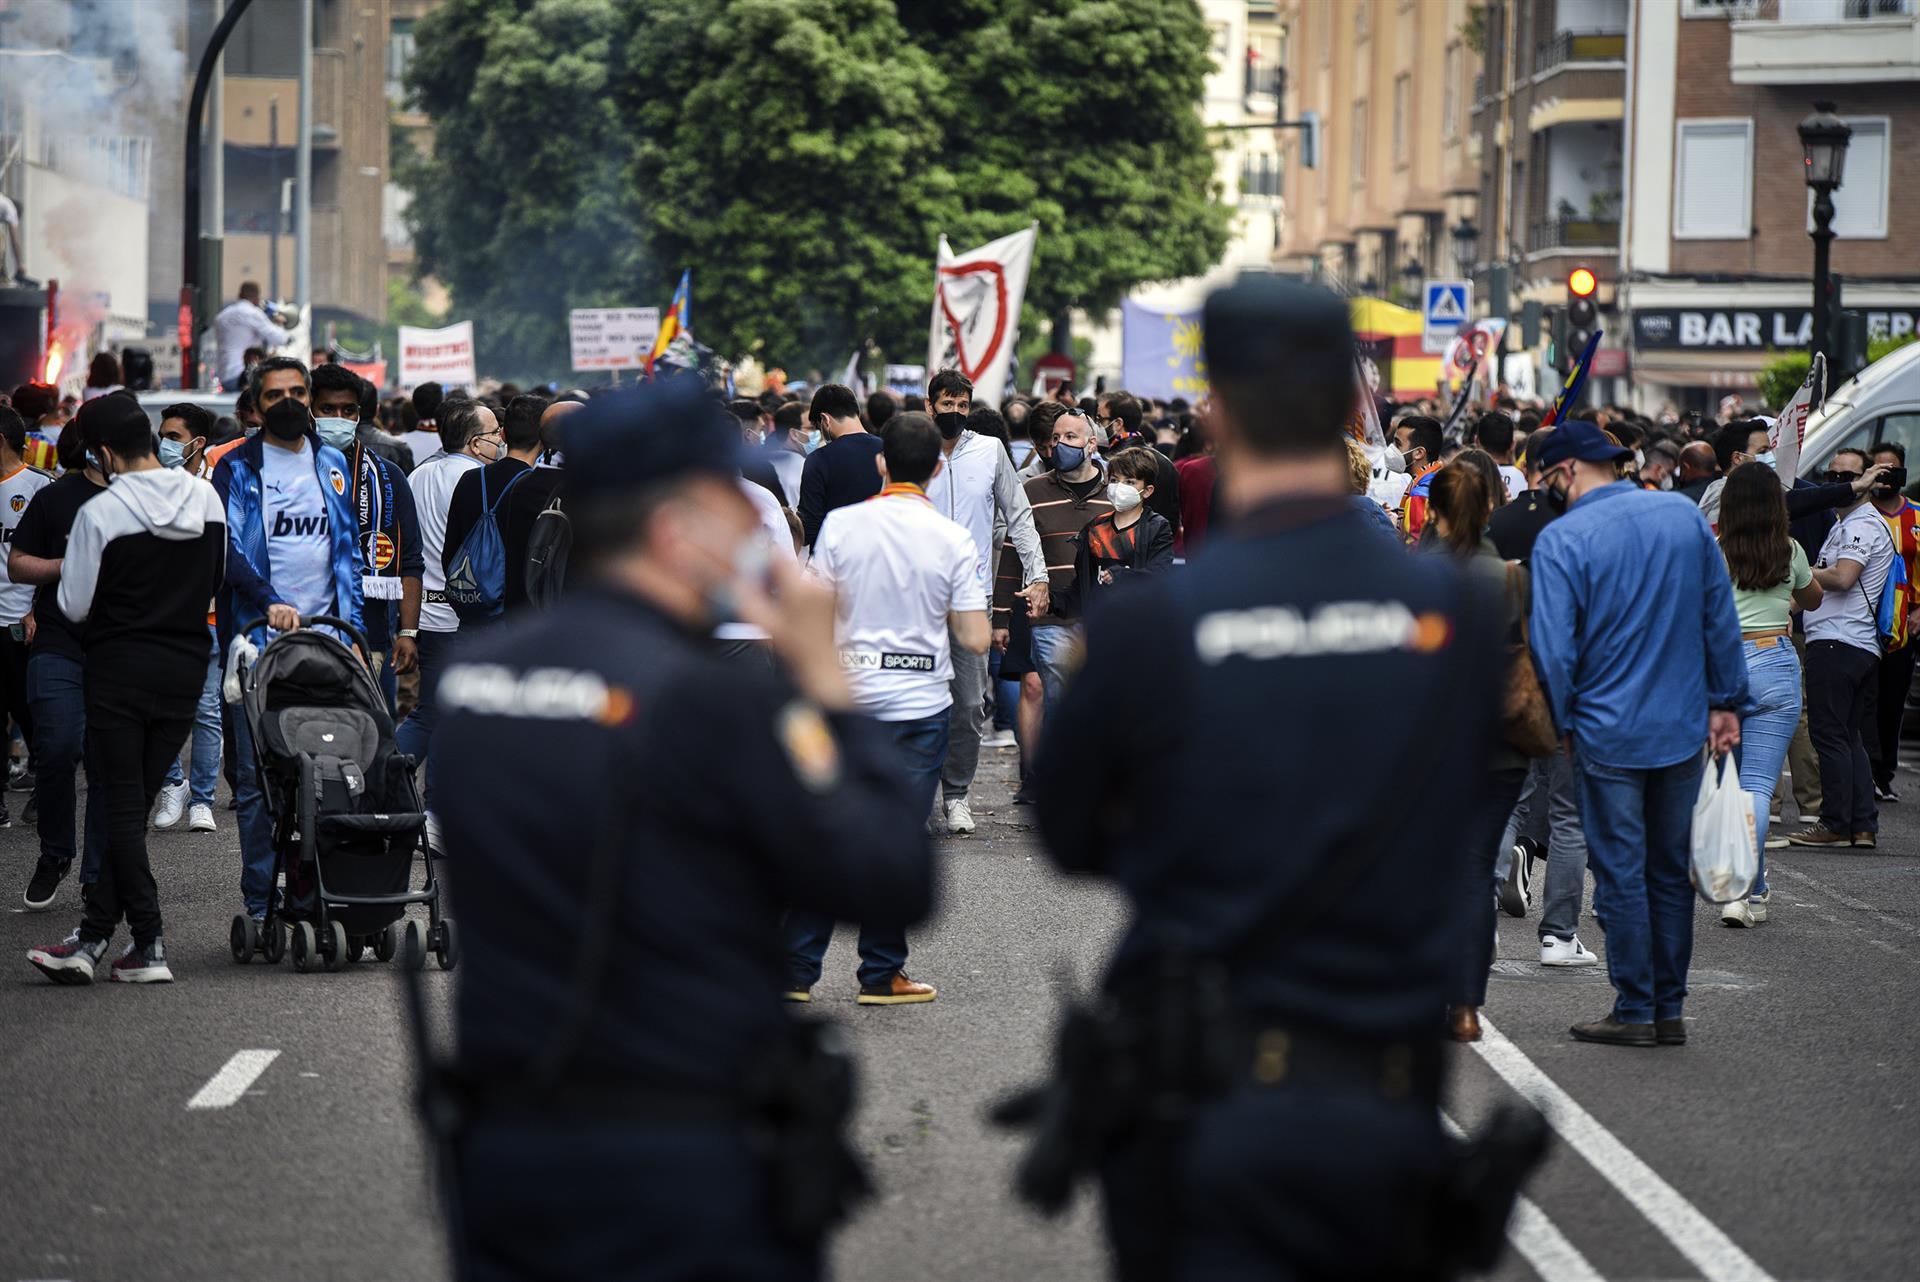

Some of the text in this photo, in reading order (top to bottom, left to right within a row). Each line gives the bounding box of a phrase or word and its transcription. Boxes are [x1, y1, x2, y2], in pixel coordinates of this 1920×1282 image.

[1679, 312, 1762, 346] BAR
[272, 507, 330, 537] bwi
[428, 592, 447, 602] SPO
[884, 654, 932, 670] SPORTS
